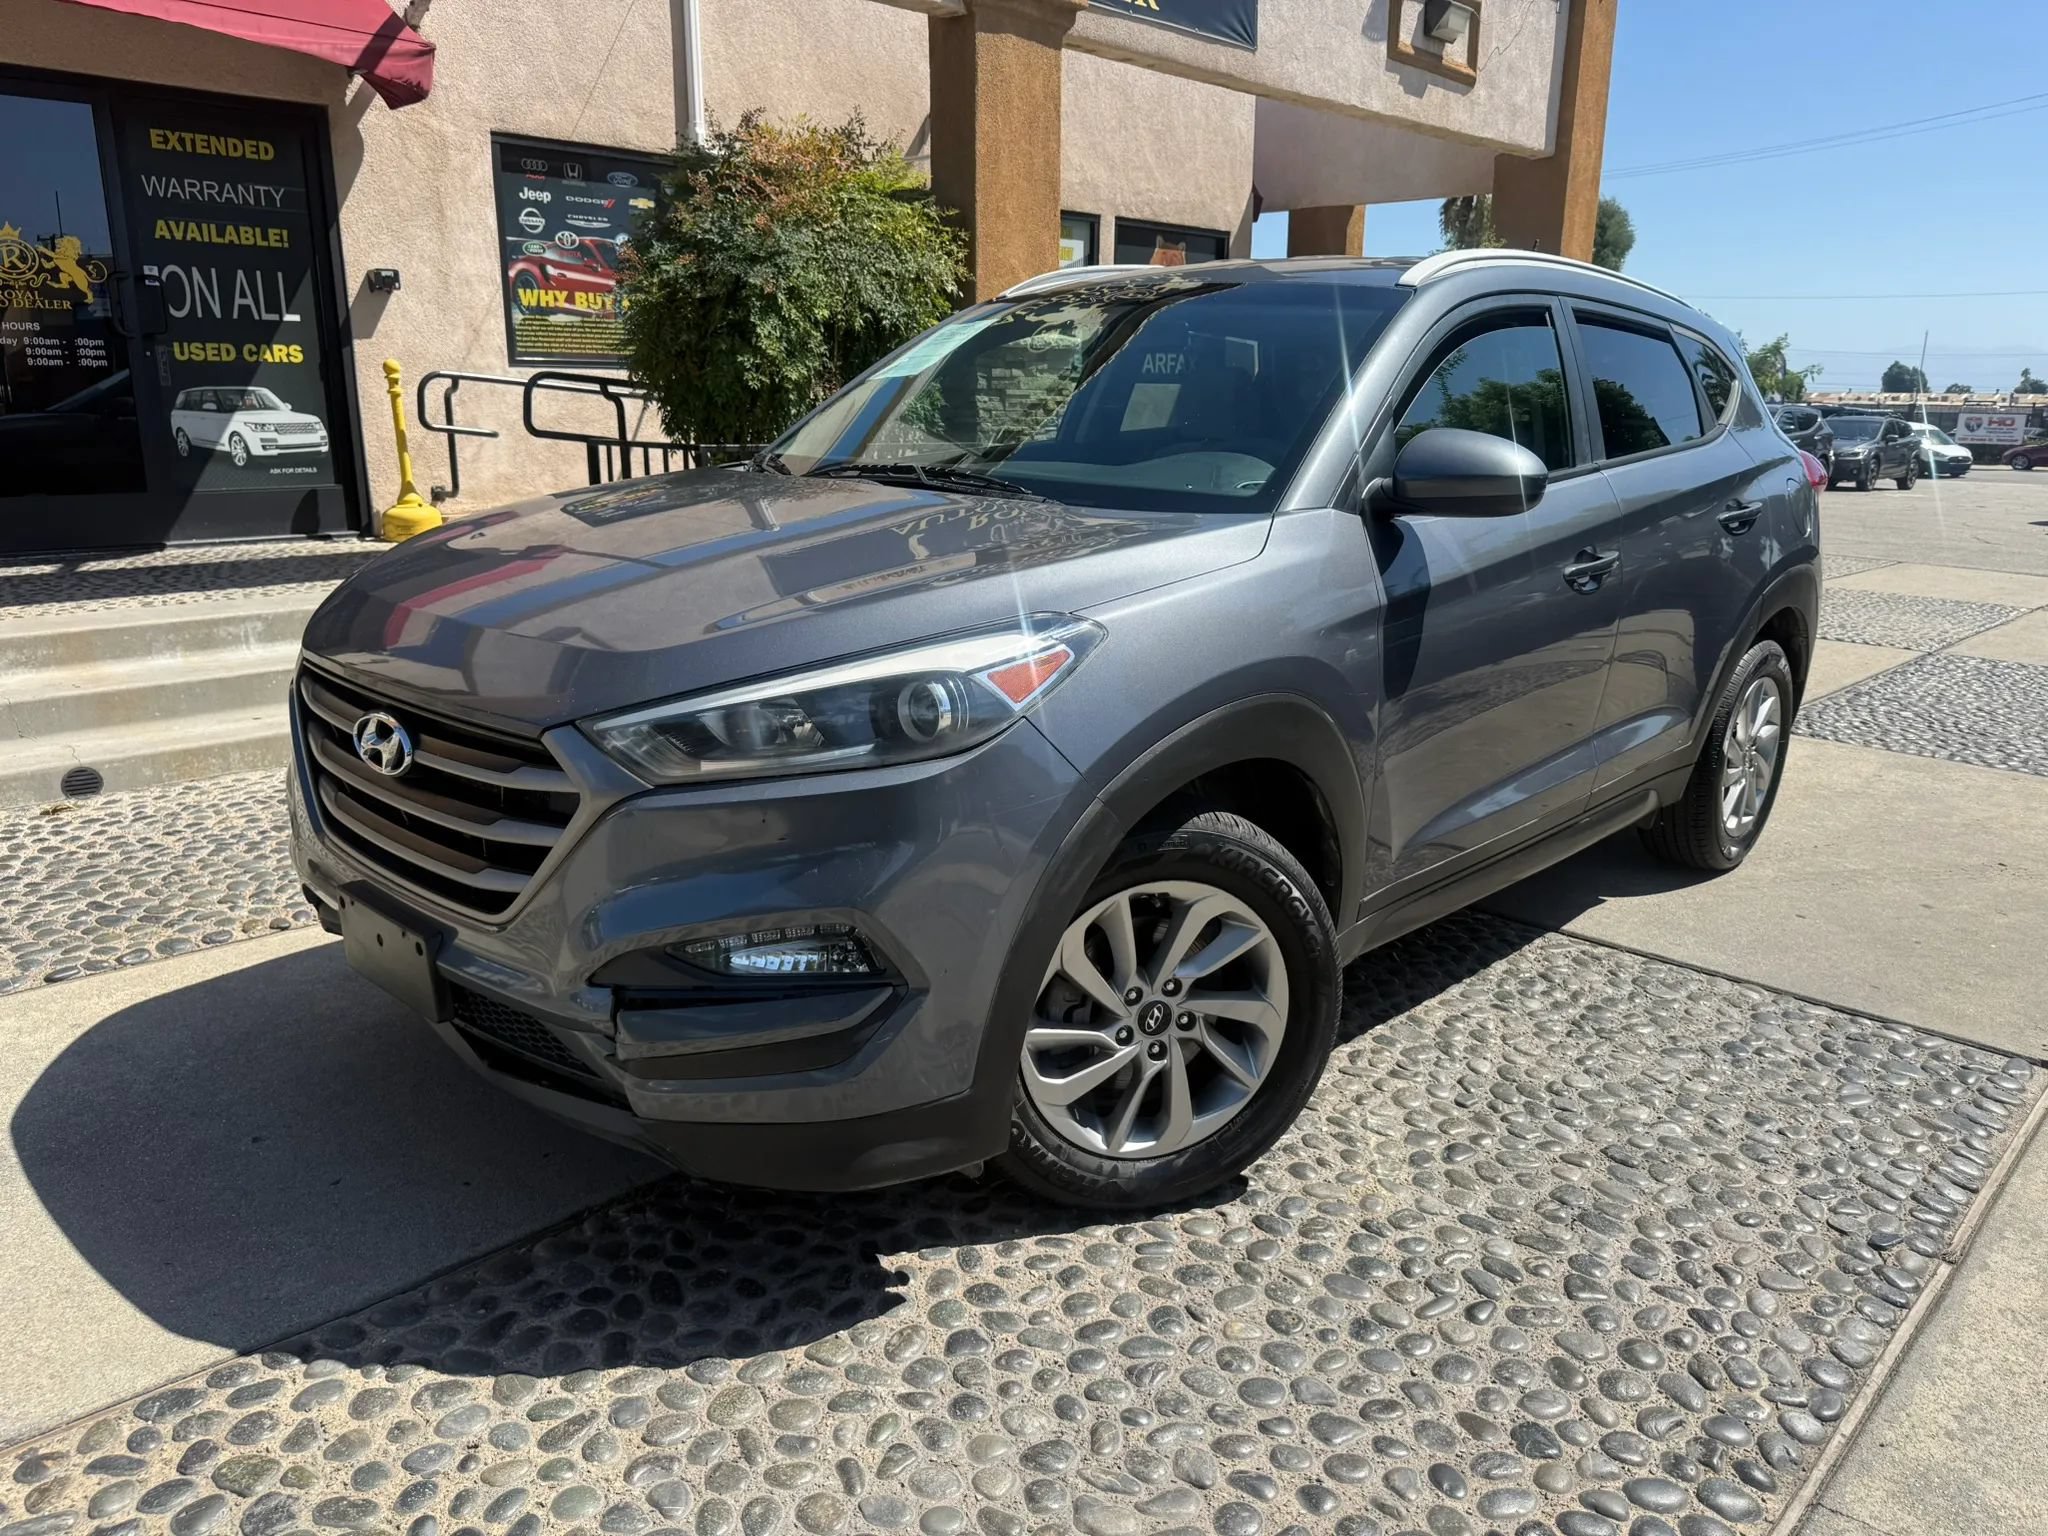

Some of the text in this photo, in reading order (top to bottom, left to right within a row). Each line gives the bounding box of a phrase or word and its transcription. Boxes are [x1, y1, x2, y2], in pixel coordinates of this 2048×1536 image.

[149, 128, 275, 161] EXTENDED
[141, 174, 286, 208] WARRANTY
[519, 186, 552, 204] Jeep
[154, 219, 290, 249] AVAILABLE!
[12, 299, 73, 311] DEALER
[232, 268, 302, 322] ALL
[518, 288, 568, 308] WHY
[574, 291, 614, 311] BUY
[2, 322, 41, 332] HOURS
[23, 337, 60, 346] 9:00am
[25, 346, 62, 356] 9:00am
[27, 356, 64, 366] 9:00am
[172, 341, 305, 364] USED CARS
